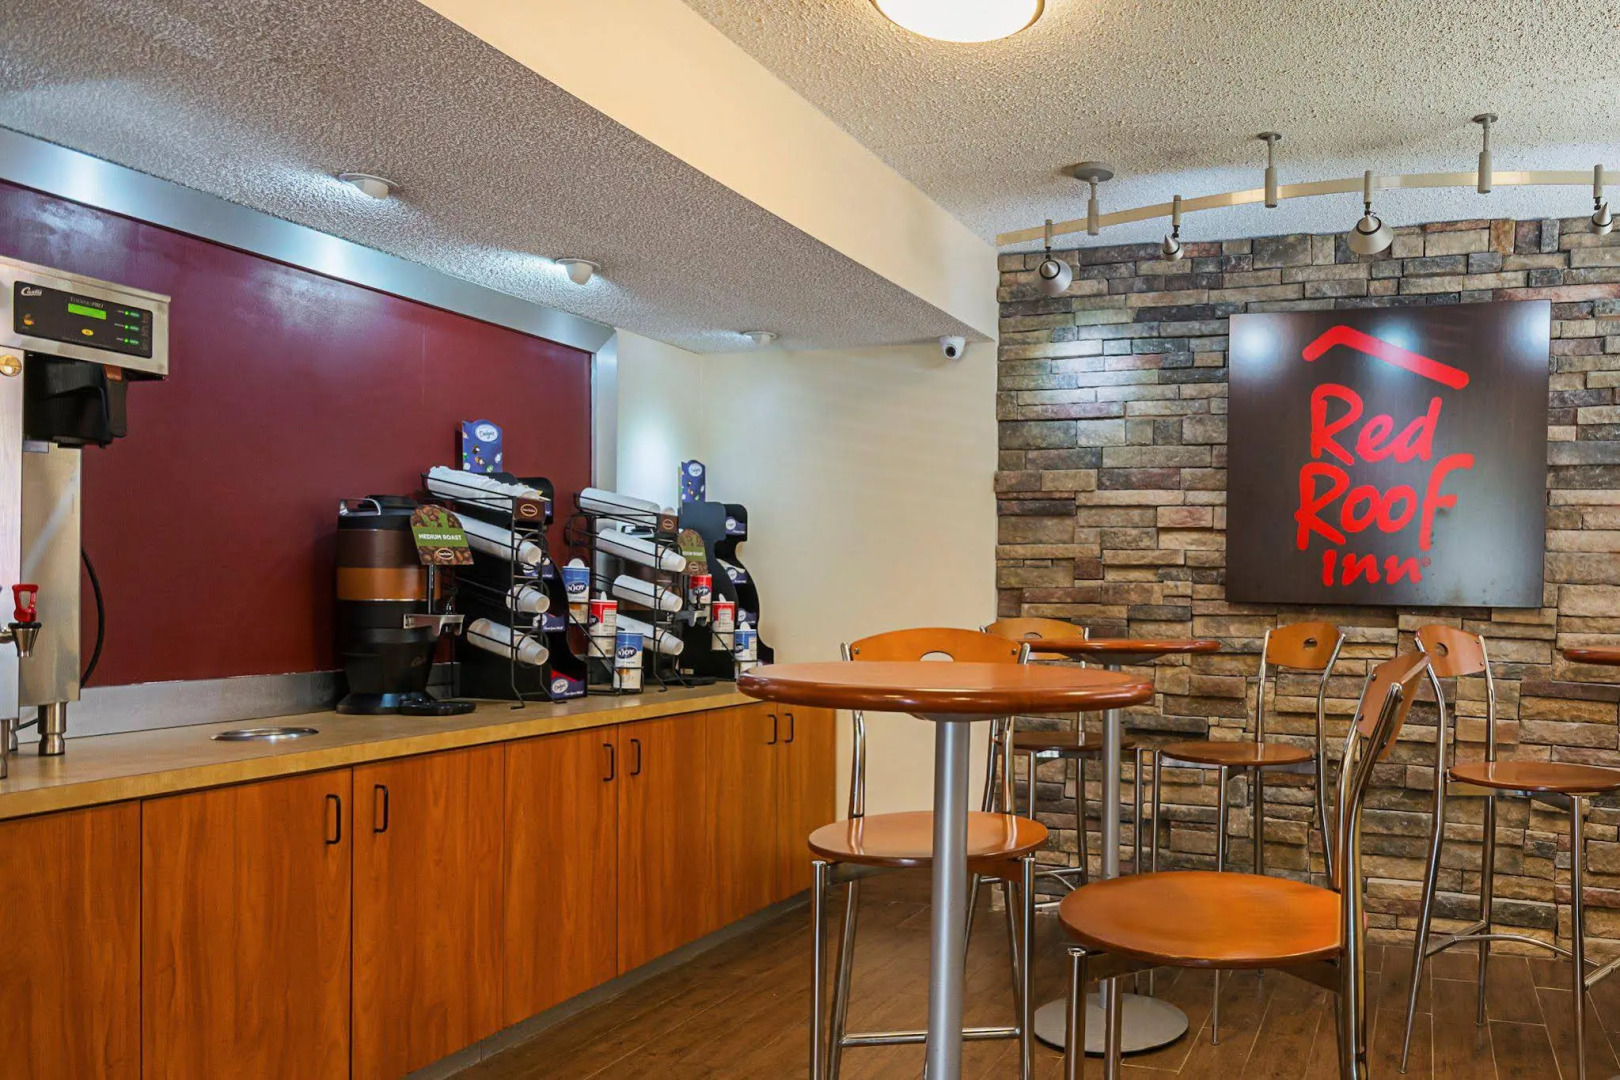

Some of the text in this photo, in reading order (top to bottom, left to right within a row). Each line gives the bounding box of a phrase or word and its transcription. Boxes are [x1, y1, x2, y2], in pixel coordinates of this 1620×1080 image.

[1310, 383, 1442, 466] Red
[418, 533, 442, 541] MEDIUM
[1294, 453, 1475, 551] Roof
